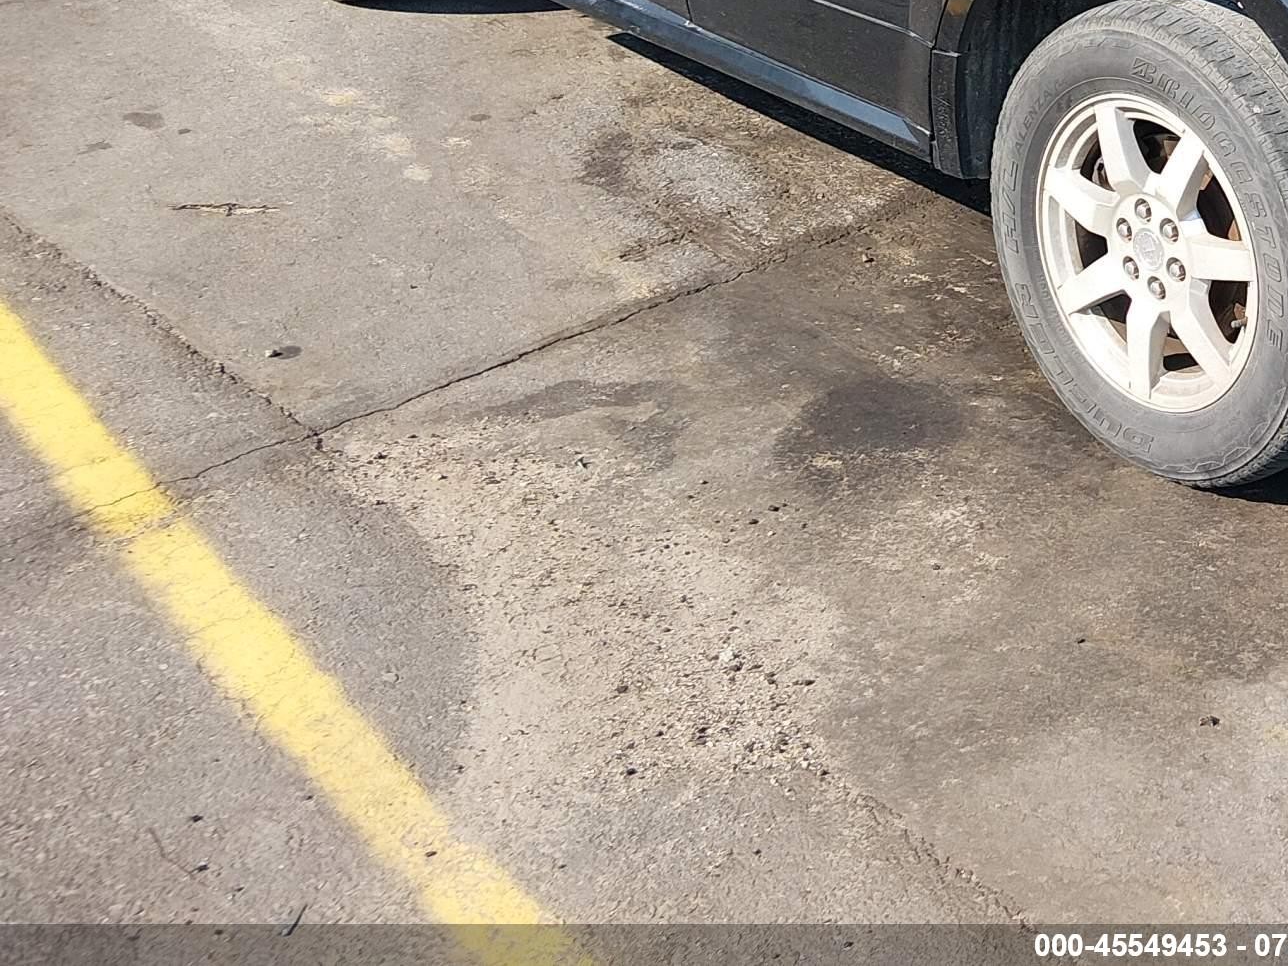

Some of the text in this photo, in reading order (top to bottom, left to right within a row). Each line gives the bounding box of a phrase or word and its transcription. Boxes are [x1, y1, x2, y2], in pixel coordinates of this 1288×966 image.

[1014, 90, 1051, 155] ALENZA
[1131, 57, 1283, 350] BRIDGESTONE
[1014, 282, 1155, 454] DUELER
